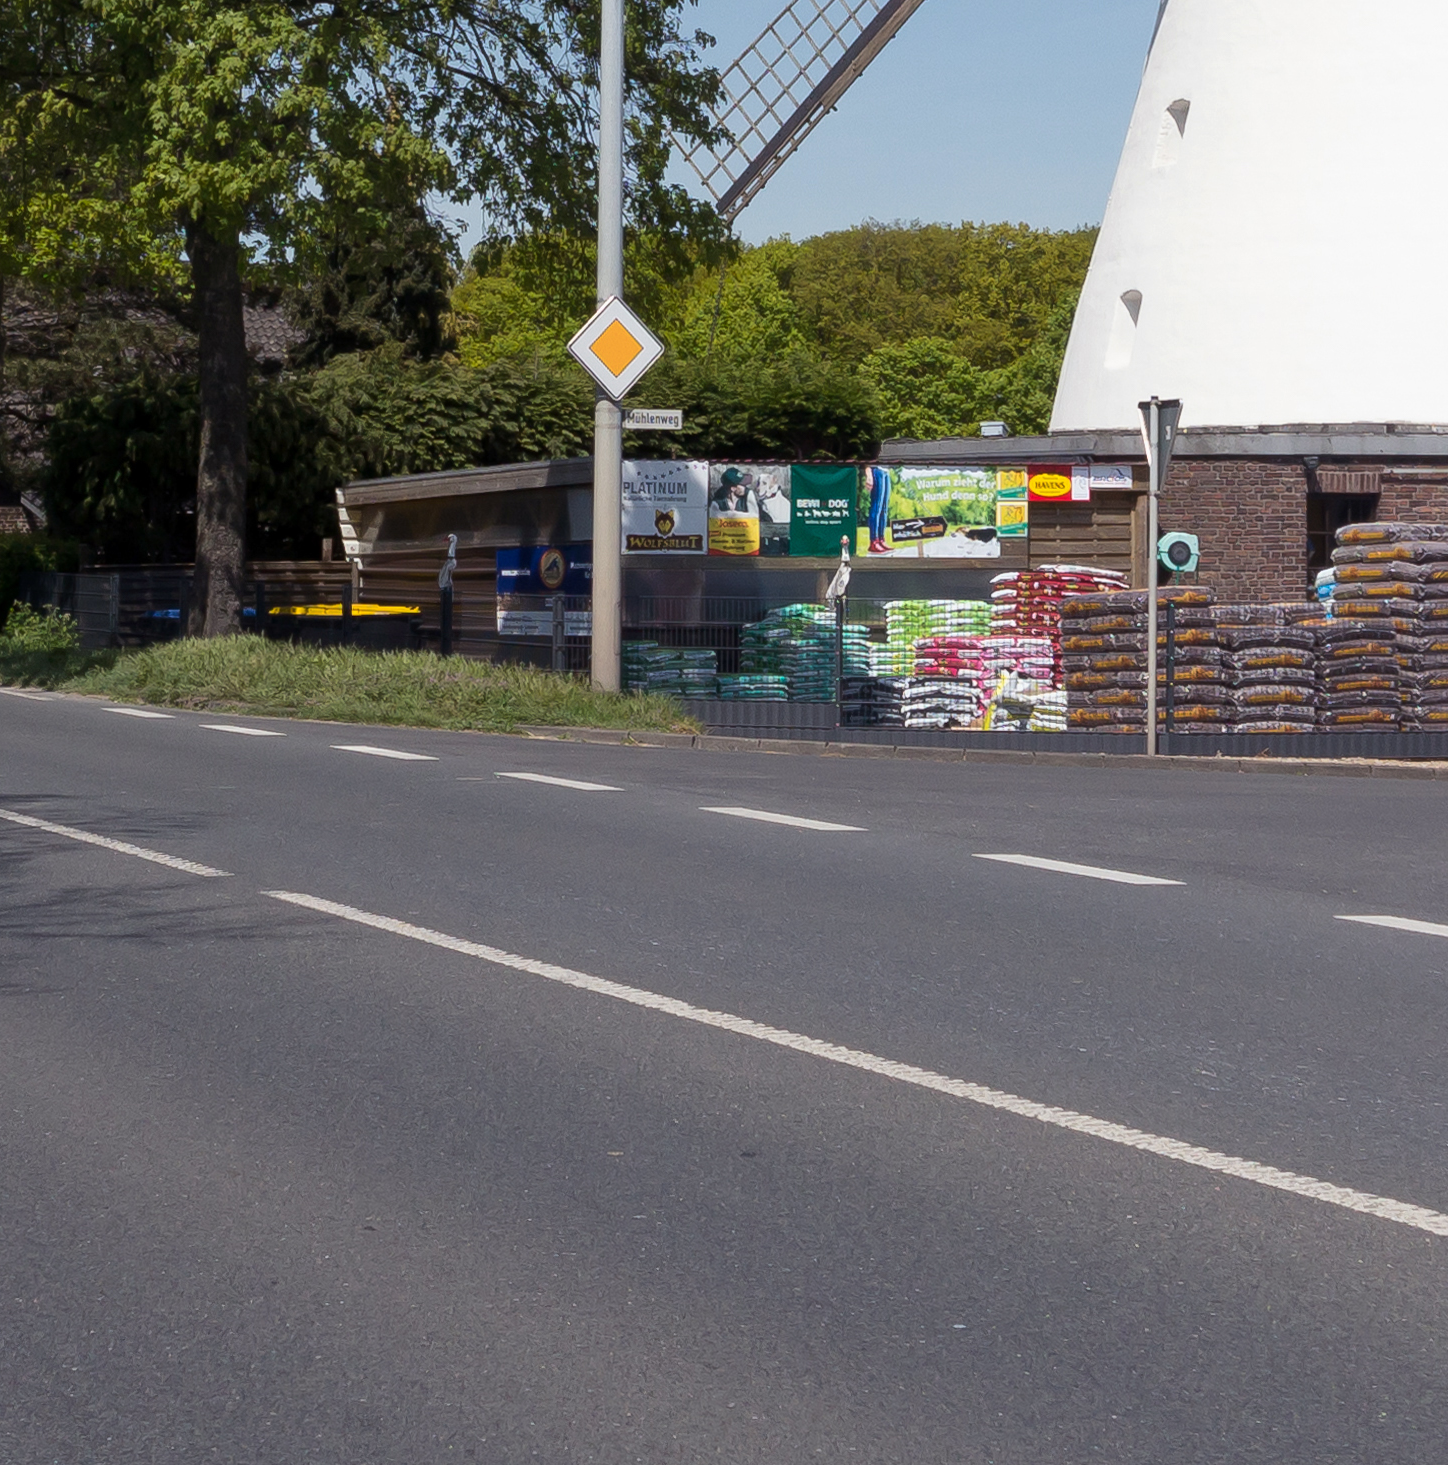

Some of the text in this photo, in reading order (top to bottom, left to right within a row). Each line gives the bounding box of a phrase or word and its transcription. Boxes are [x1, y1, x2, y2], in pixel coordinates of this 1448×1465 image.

[627, 412, 679, 428] Mühlenweg
[623, 482, 687, 494] PLATINUM
[916, 474, 995, 490] Warum zieht der
[1035, 481, 1066, 490] HAVENS
[923, 490, 950, 502] Hund
[951, 490, 976, 501] denn
[978, 489, 995, 502] so?
[828, 499, 849, 508] DOG
[630, 537, 700, 549] WOLFSBLUT
